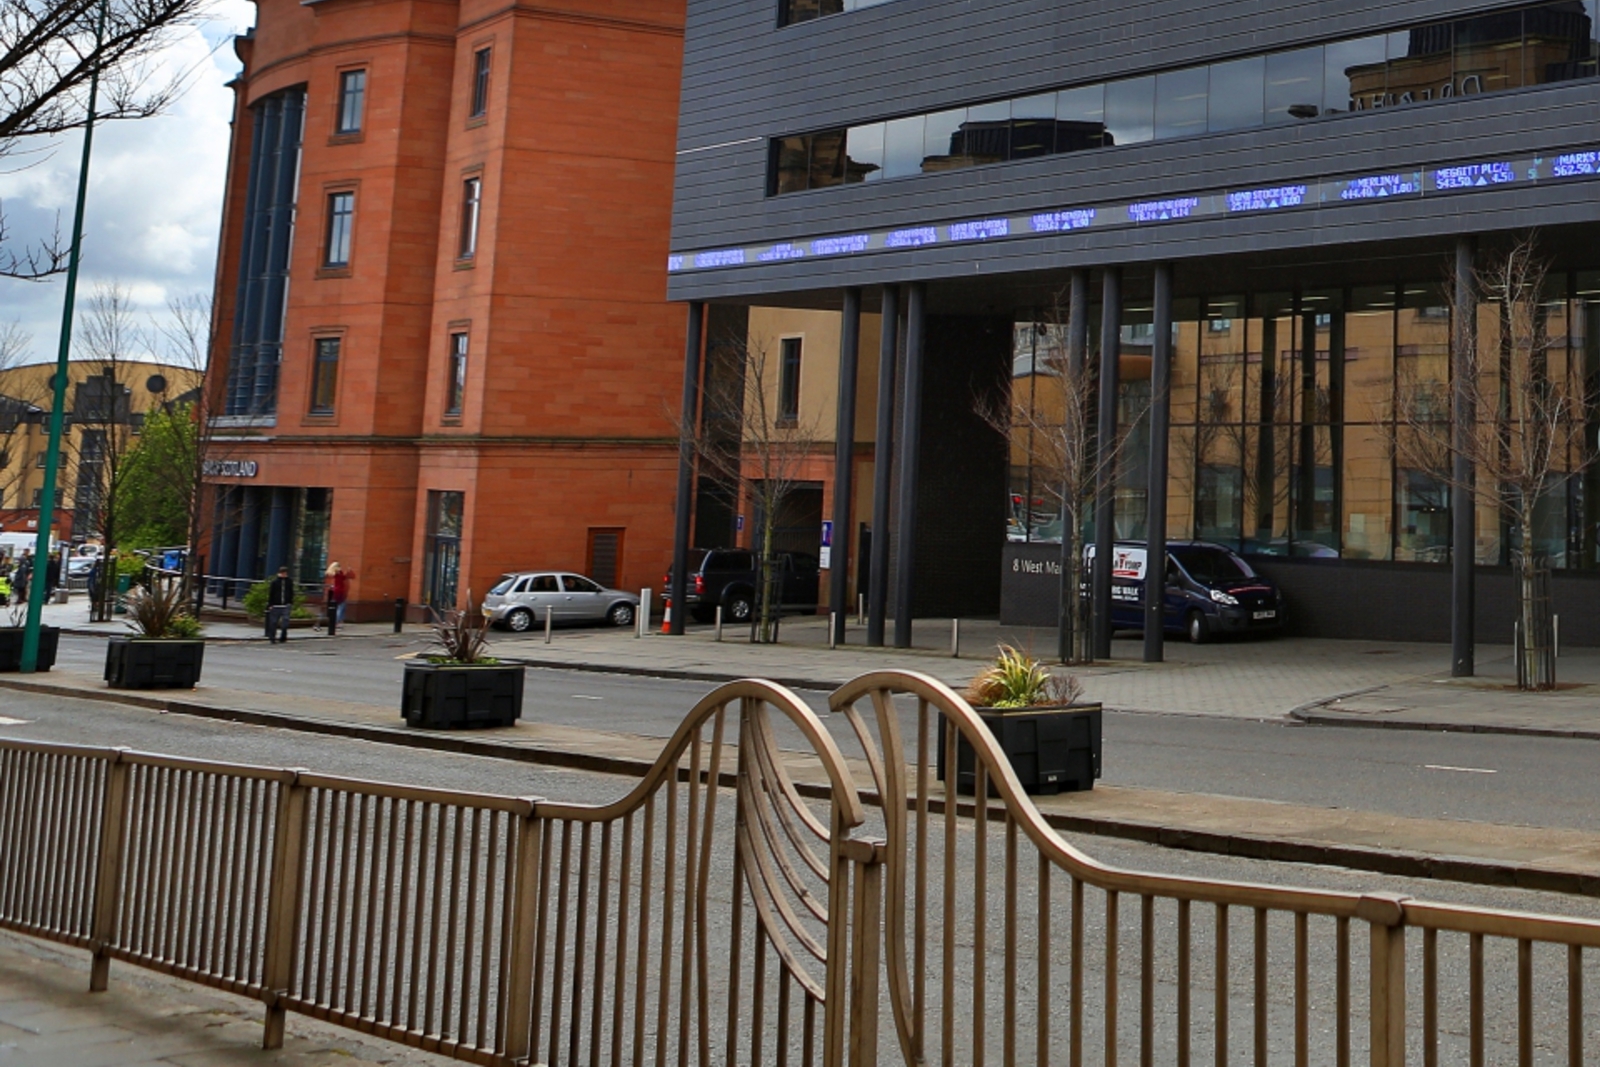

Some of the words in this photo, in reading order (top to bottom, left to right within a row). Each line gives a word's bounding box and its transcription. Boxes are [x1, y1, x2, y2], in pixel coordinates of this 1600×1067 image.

[1560, 152, 1595, 165] MARKS
[1012, 558, 1019, 572] 8
[1021, 559, 1043, 573] West
